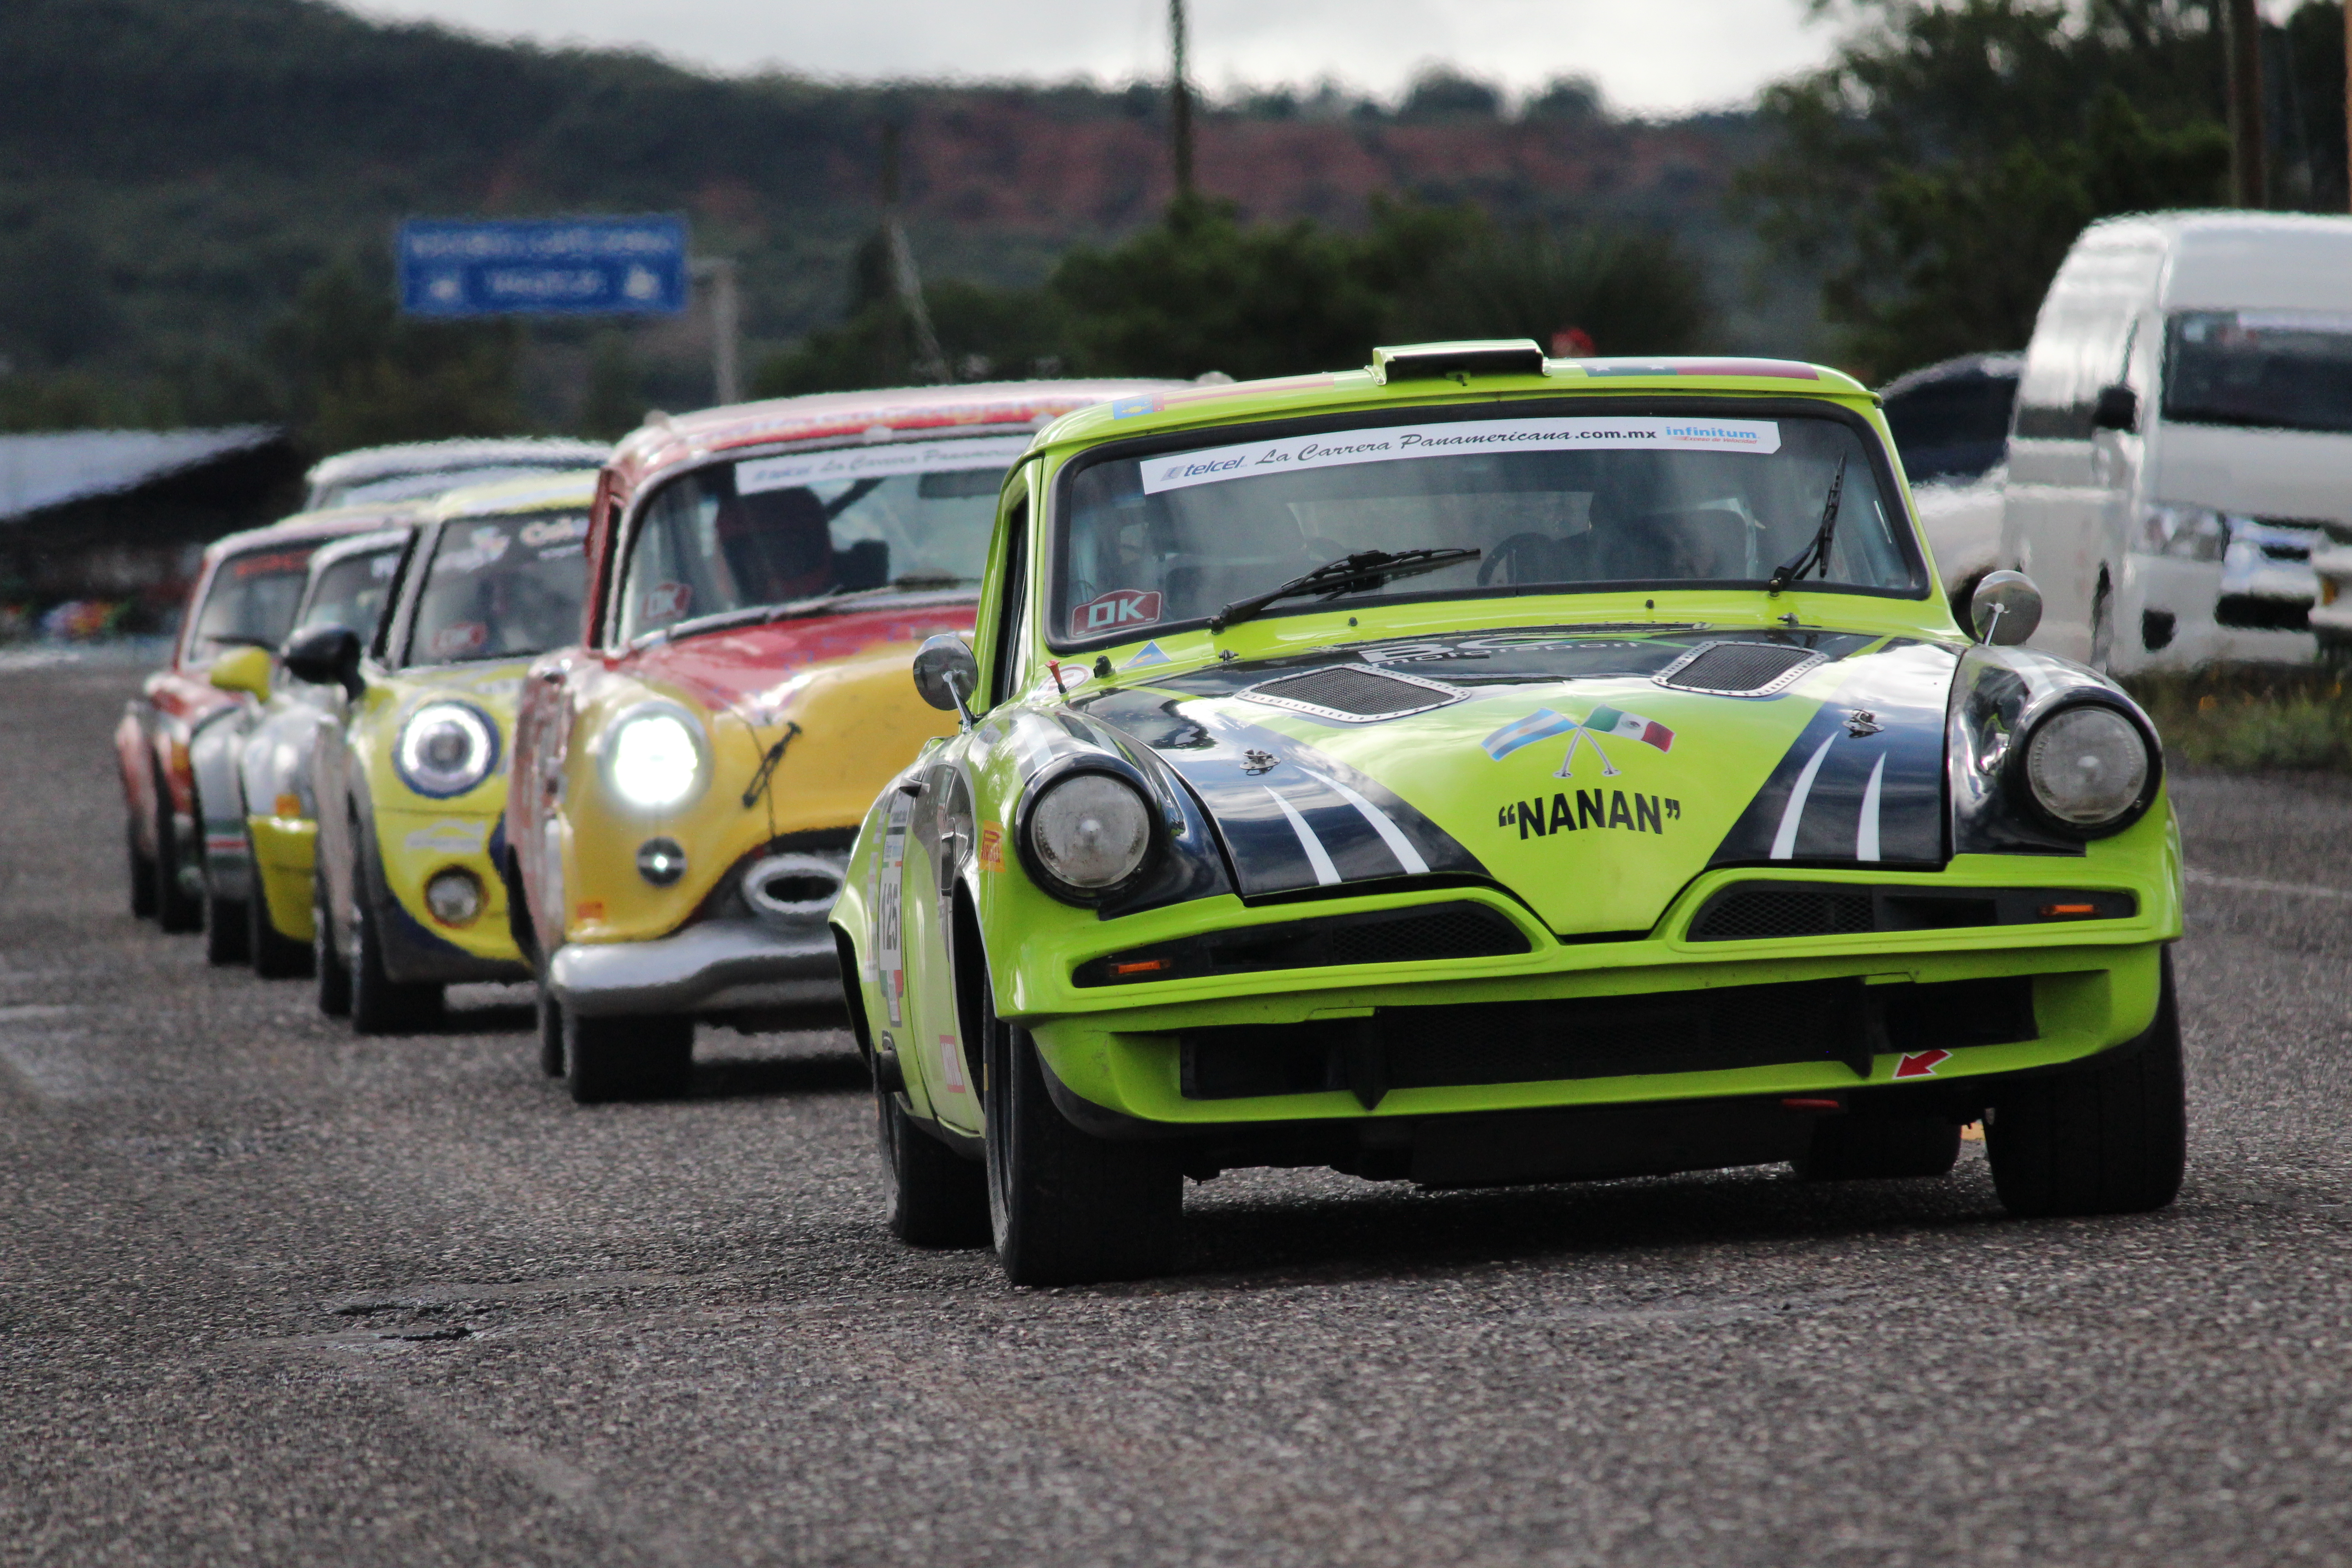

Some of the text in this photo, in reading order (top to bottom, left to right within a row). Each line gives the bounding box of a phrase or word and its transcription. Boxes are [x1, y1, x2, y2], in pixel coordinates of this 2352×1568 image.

[1666, 426, 1759, 439] infinitum
[1183, 455, 1246, 477] telcel
[1255, 449, 1291, 465] La
[1298, 441, 1392, 461] Carrera
[1088, 595, 1147, 628] OK
[1372, 642, 1642, 668] motorsport
[882, 882, 899, 951] 125
